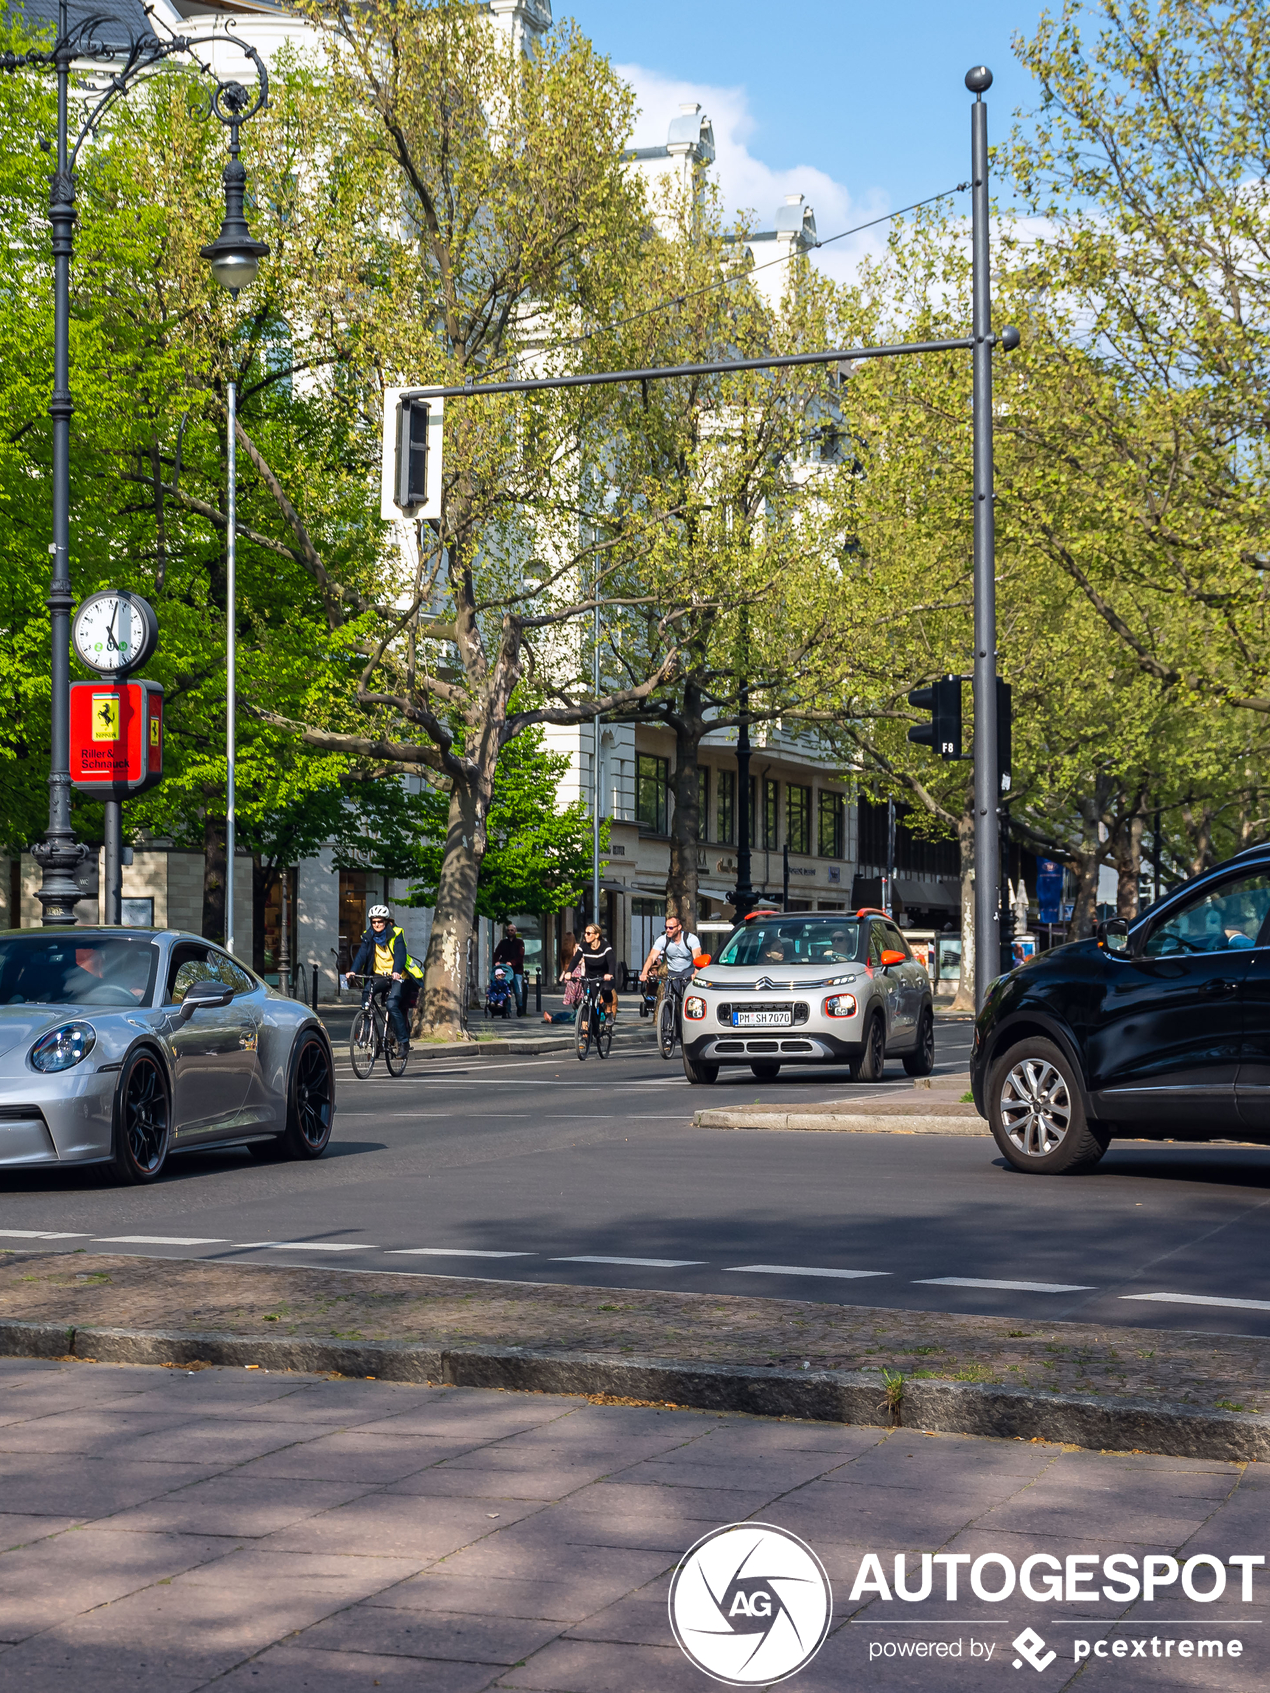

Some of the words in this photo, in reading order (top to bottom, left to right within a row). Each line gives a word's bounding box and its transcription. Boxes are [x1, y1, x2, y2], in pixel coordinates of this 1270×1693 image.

[942, 742, 953, 753] F8
[81, 748, 106, 759] Riller
[107, 748, 114, 759] &
[81, 758, 130, 769] Schnauck
[739, 1014, 750, 1023] PM
[755, 1013, 767, 1023] SH
[768, 1013, 789, 1023] 7070
